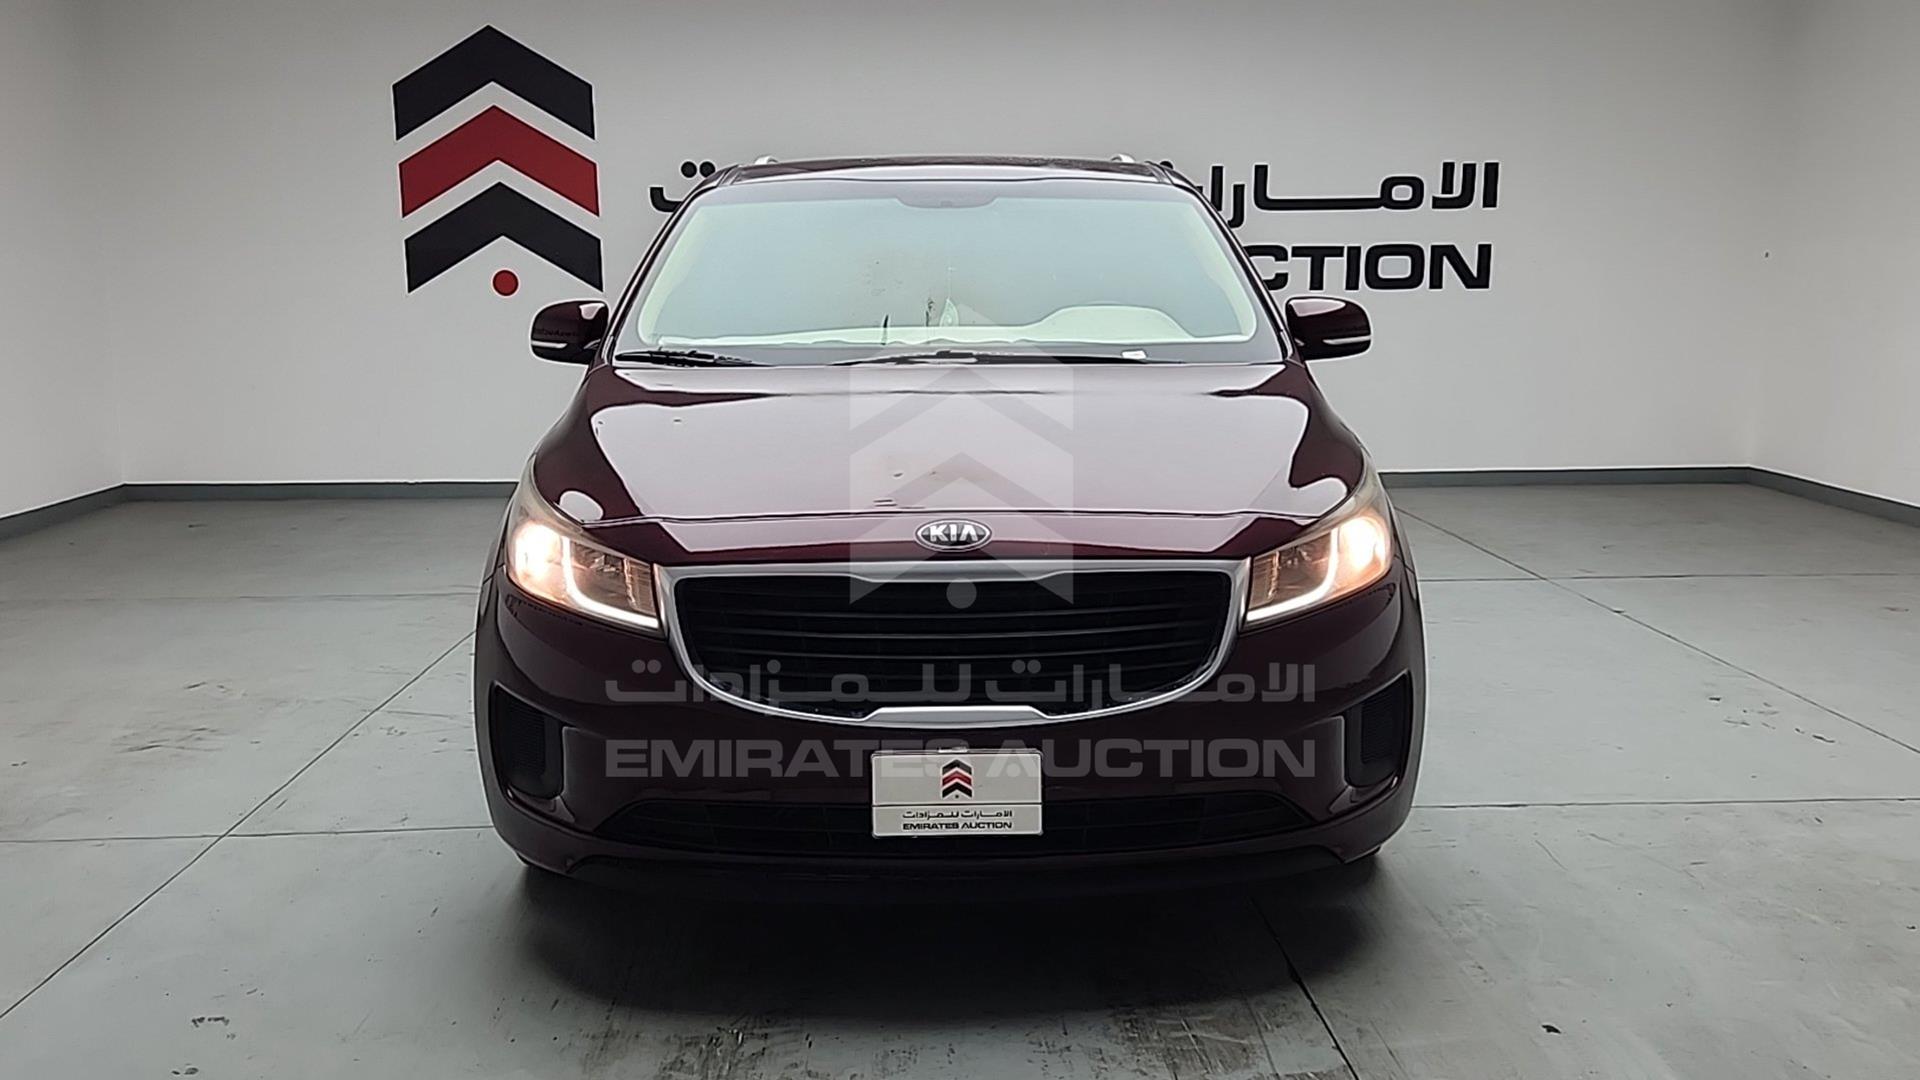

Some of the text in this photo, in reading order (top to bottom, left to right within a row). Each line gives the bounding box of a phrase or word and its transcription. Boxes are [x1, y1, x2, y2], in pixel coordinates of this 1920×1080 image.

[1160, 161, 1499, 229] الامارا
[1243, 243, 1492, 291] CTION
[930, 524, 979, 542] KIA
[961, 810, 1013, 820] الامارات
